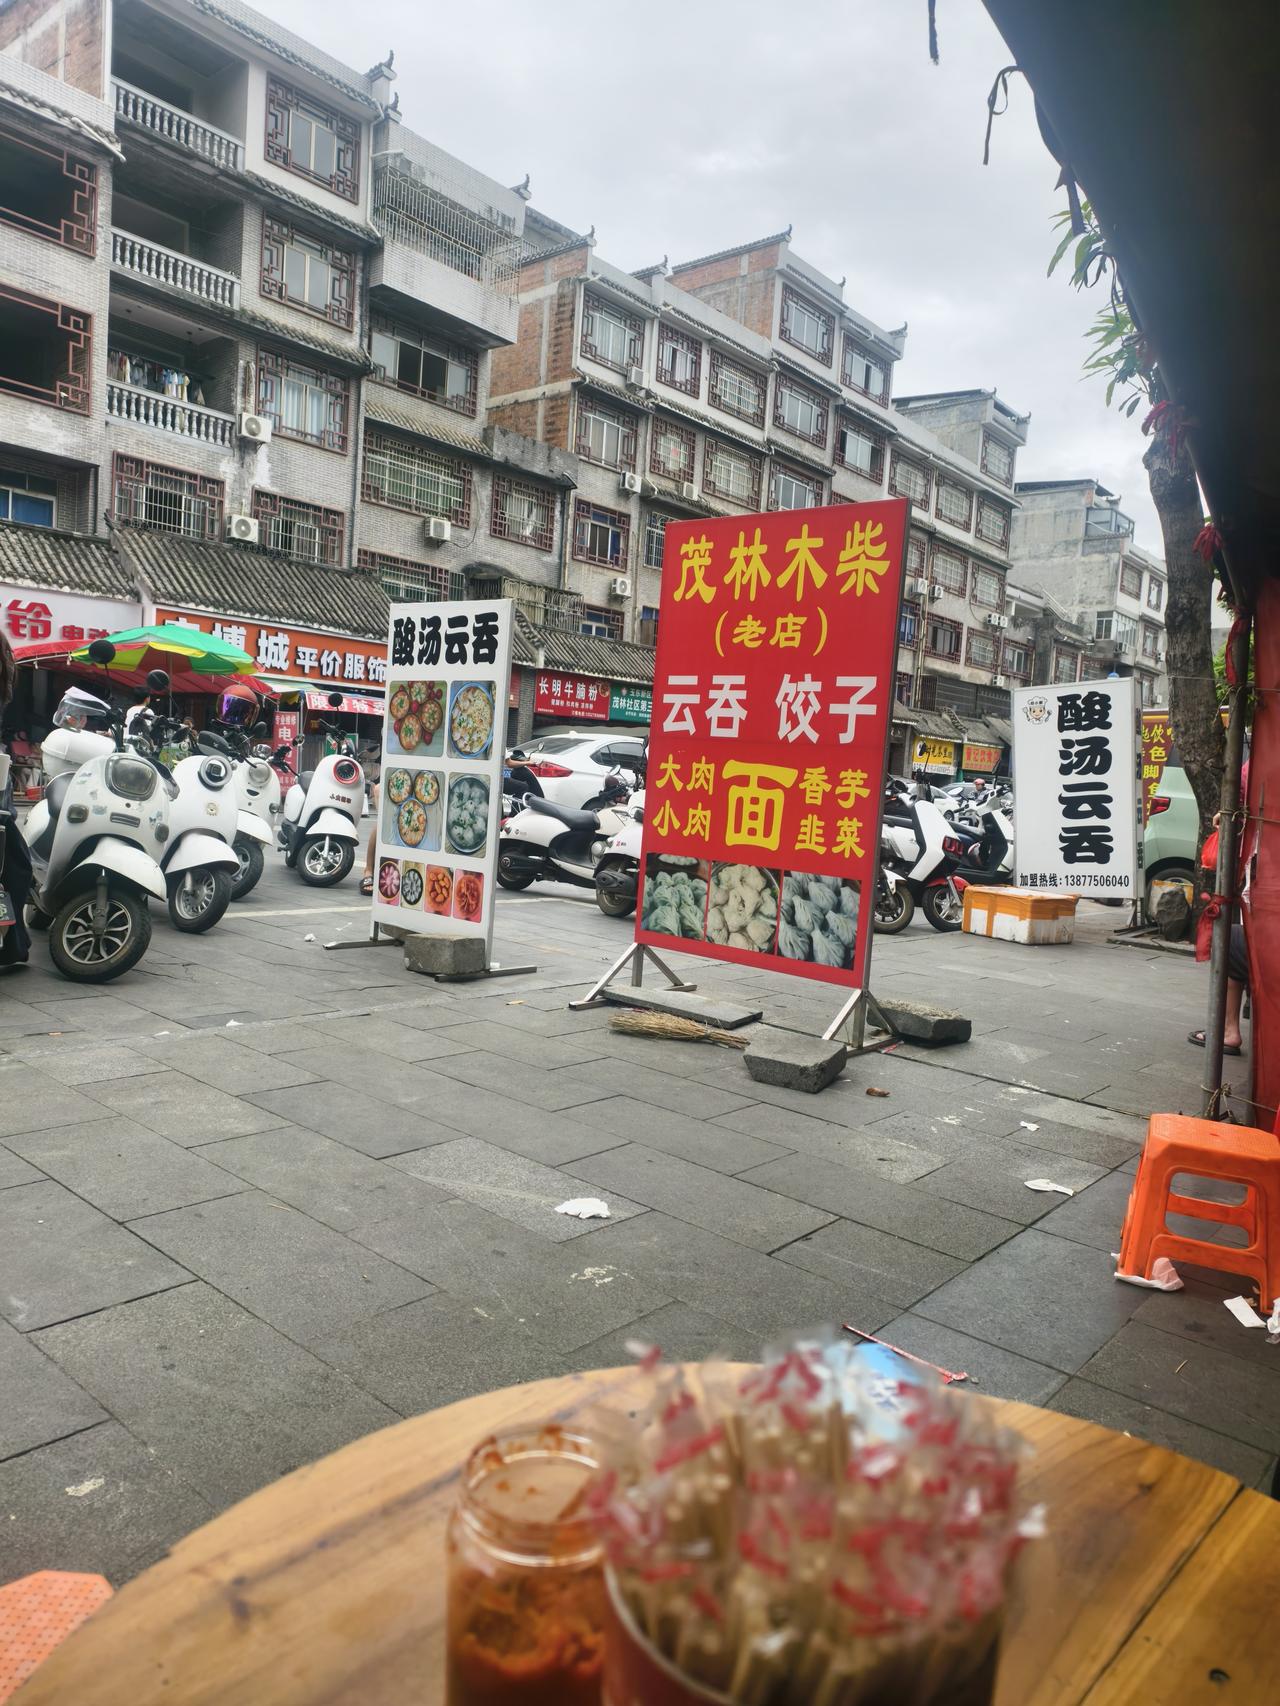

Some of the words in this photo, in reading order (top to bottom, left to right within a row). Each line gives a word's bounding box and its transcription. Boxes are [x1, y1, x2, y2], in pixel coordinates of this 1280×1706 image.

[673, 520, 891, 604] 茂林木柴
[296, 646, 387, 682] 平价服饰
[391, 611, 500, 667] 酸汤云吞
[714, 606, 828, 657] (老店)
[662, 674, 748, 738] 云吞
[775, 673, 877, 744] 饺子
[655, 754, 715, 795] 大肉
[721, 760, 799, 851] 面
[799, 767, 870, 809] 香芋
[1056, 691, 1114, 865] 酸汤云吞
[652, 799, 712, 841] 小肉
[794, 814, 865, 858] 韭菜
